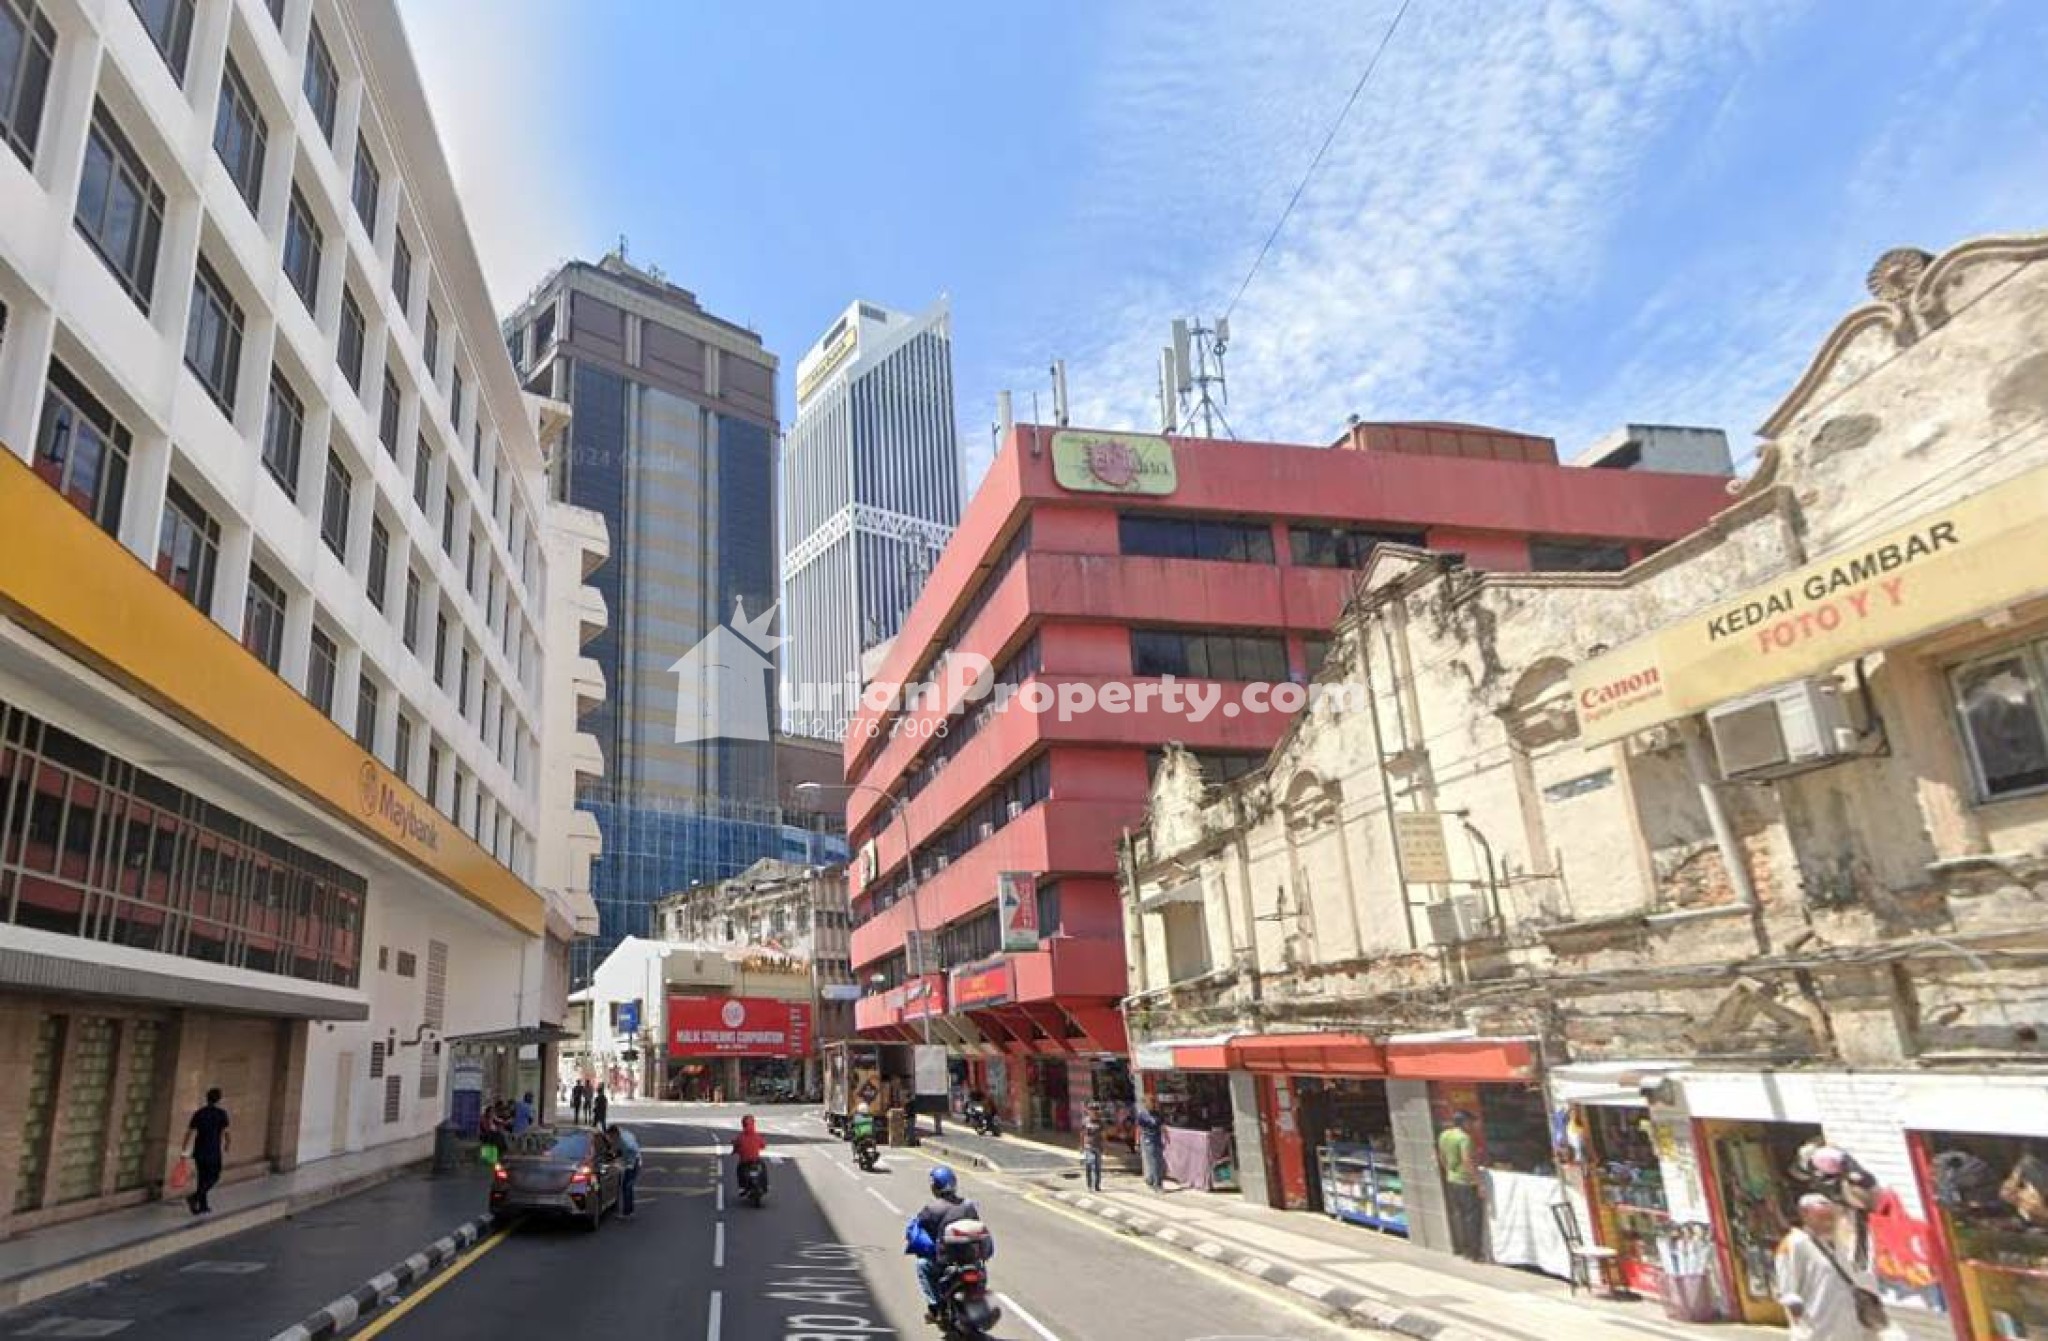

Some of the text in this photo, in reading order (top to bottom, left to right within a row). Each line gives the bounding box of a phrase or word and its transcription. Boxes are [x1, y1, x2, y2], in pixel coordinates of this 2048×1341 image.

[1707, 520, 1959, 641] KEDAI GAMBAR
[1756, 577, 1906, 654] FOTO Y Y
[1580, 666, 1661, 708] Canon
[378, 782, 439, 854] Maybank
